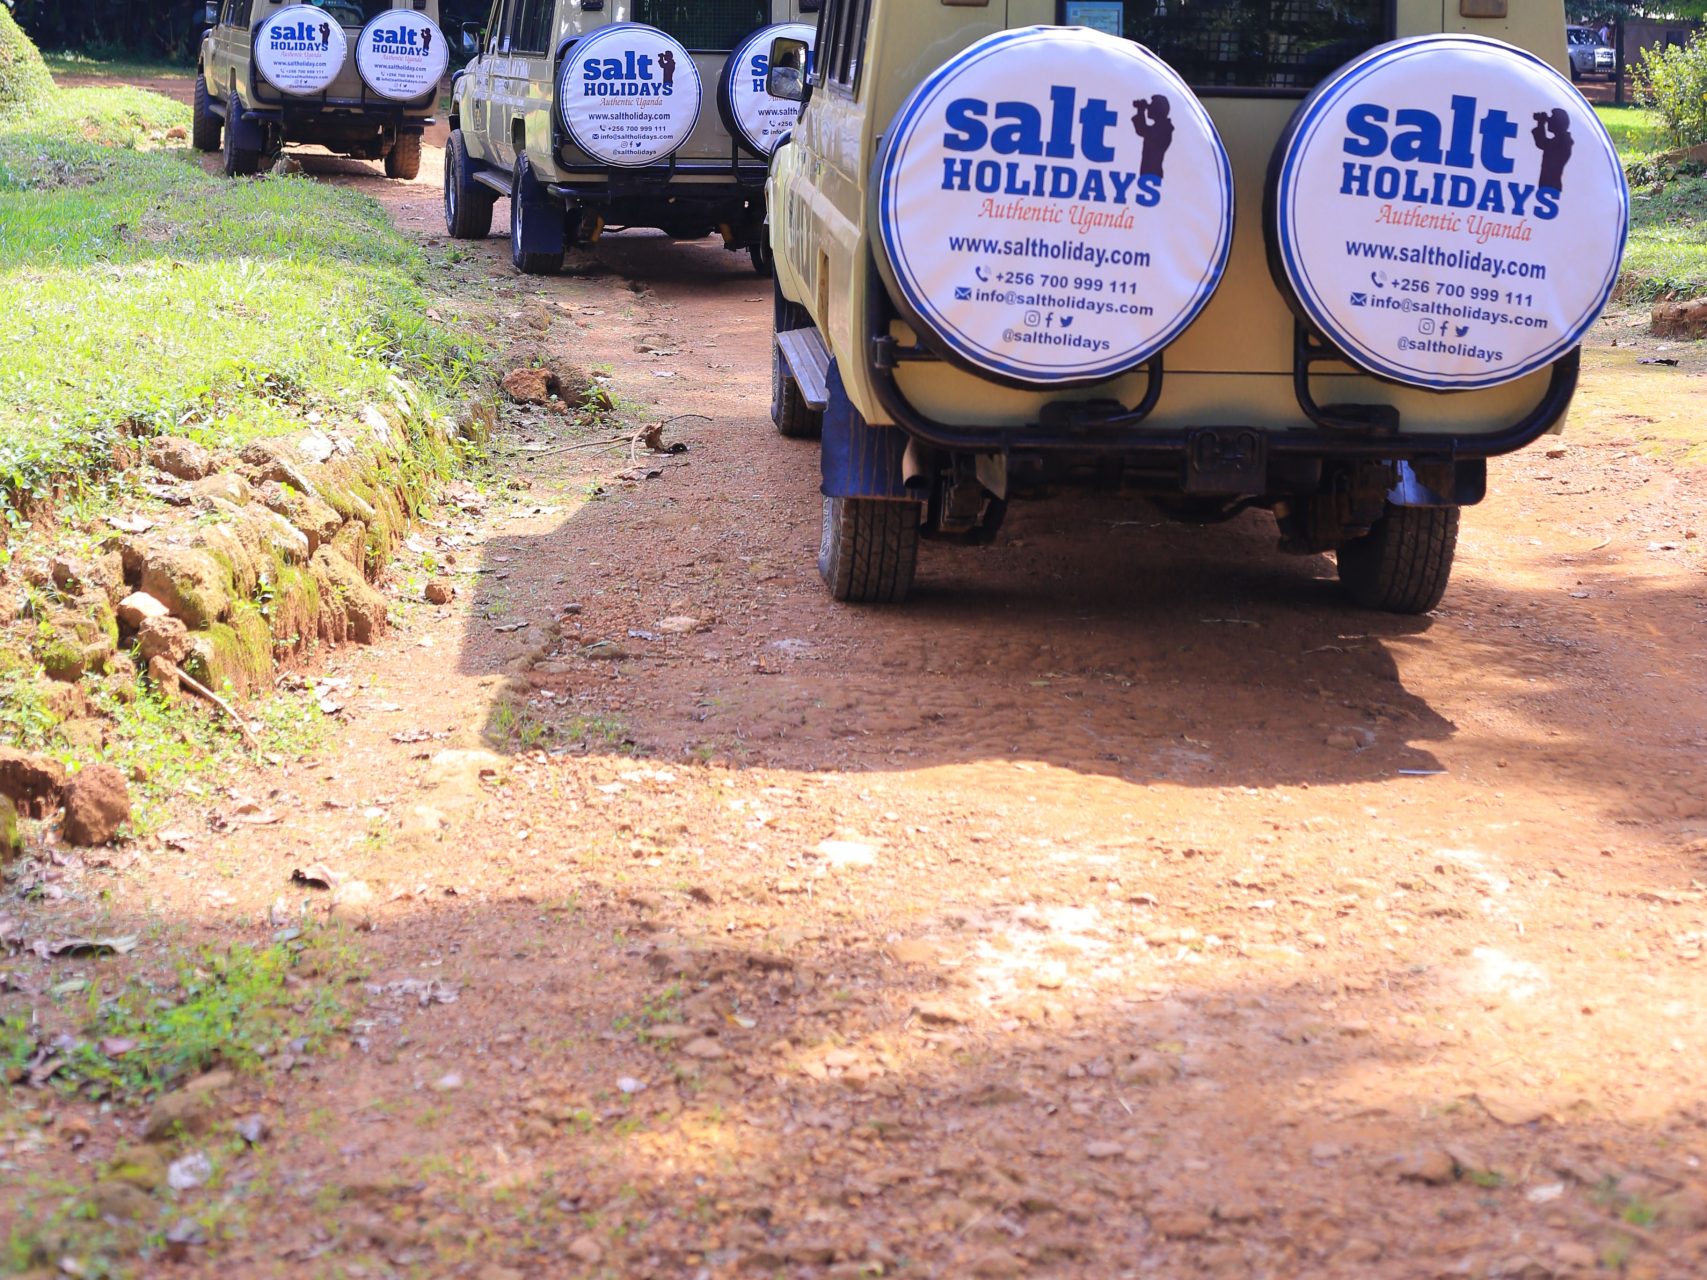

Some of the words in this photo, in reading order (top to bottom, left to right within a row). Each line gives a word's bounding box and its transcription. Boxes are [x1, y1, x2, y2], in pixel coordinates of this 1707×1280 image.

[270, 22, 316, 41] salt
[372, 26, 418, 45] salt
[270, 41, 329, 52] HOLIDAYS
[372, 44, 429, 57] HOLIDAYS
[583, 51, 653, 80] salt
[583, 81, 673, 96] HOLIDAYS
[600, 96, 634, 106] Authentic
[635, 96, 663, 109] Uganda
[588, 112, 671, 122] www.saltholiday.com
[943, 85, 1118, 163] salt
[600, 133, 674, 141] info@saltholidays.com
[1342, 94, 1518, 173] salt
[941, 157, 1163, 208] HOLIDAYS
[1339, 162, 1561, 221] HOLIDAYS
[978, 197, 1063, 224] Authentic
[1069, 204, 1136, 235] Uganda
[1375, 204, 1461, 232] Authentic
[1467, 214, 1533, 245] Uganda
[949, 236, 1151, 268] www.saltholiday.com
[1346, 240, 1547, 280] www.saltholiday.com
[996, 271, 1034, 286] +256
[1040, 274, 1069, 289] 700
[1073, 277, 1103, 292] 999
[1109, 280, 1138, 295] 111
[1391, 278, 1430, 293] +256
[1436, 282, 1465, 298] 700
[1470, 286, 1499, 302] 999
[1505, 291, 1533, 307] 111
[975, 288, 1154, 317] info@saltholidays.com
[1370, 294, 1549, 329] info@saltholidays.com
[1002, 329, 1111, 352] @saltholidays
[1397, 336, 1503, 361] @saltholidays
